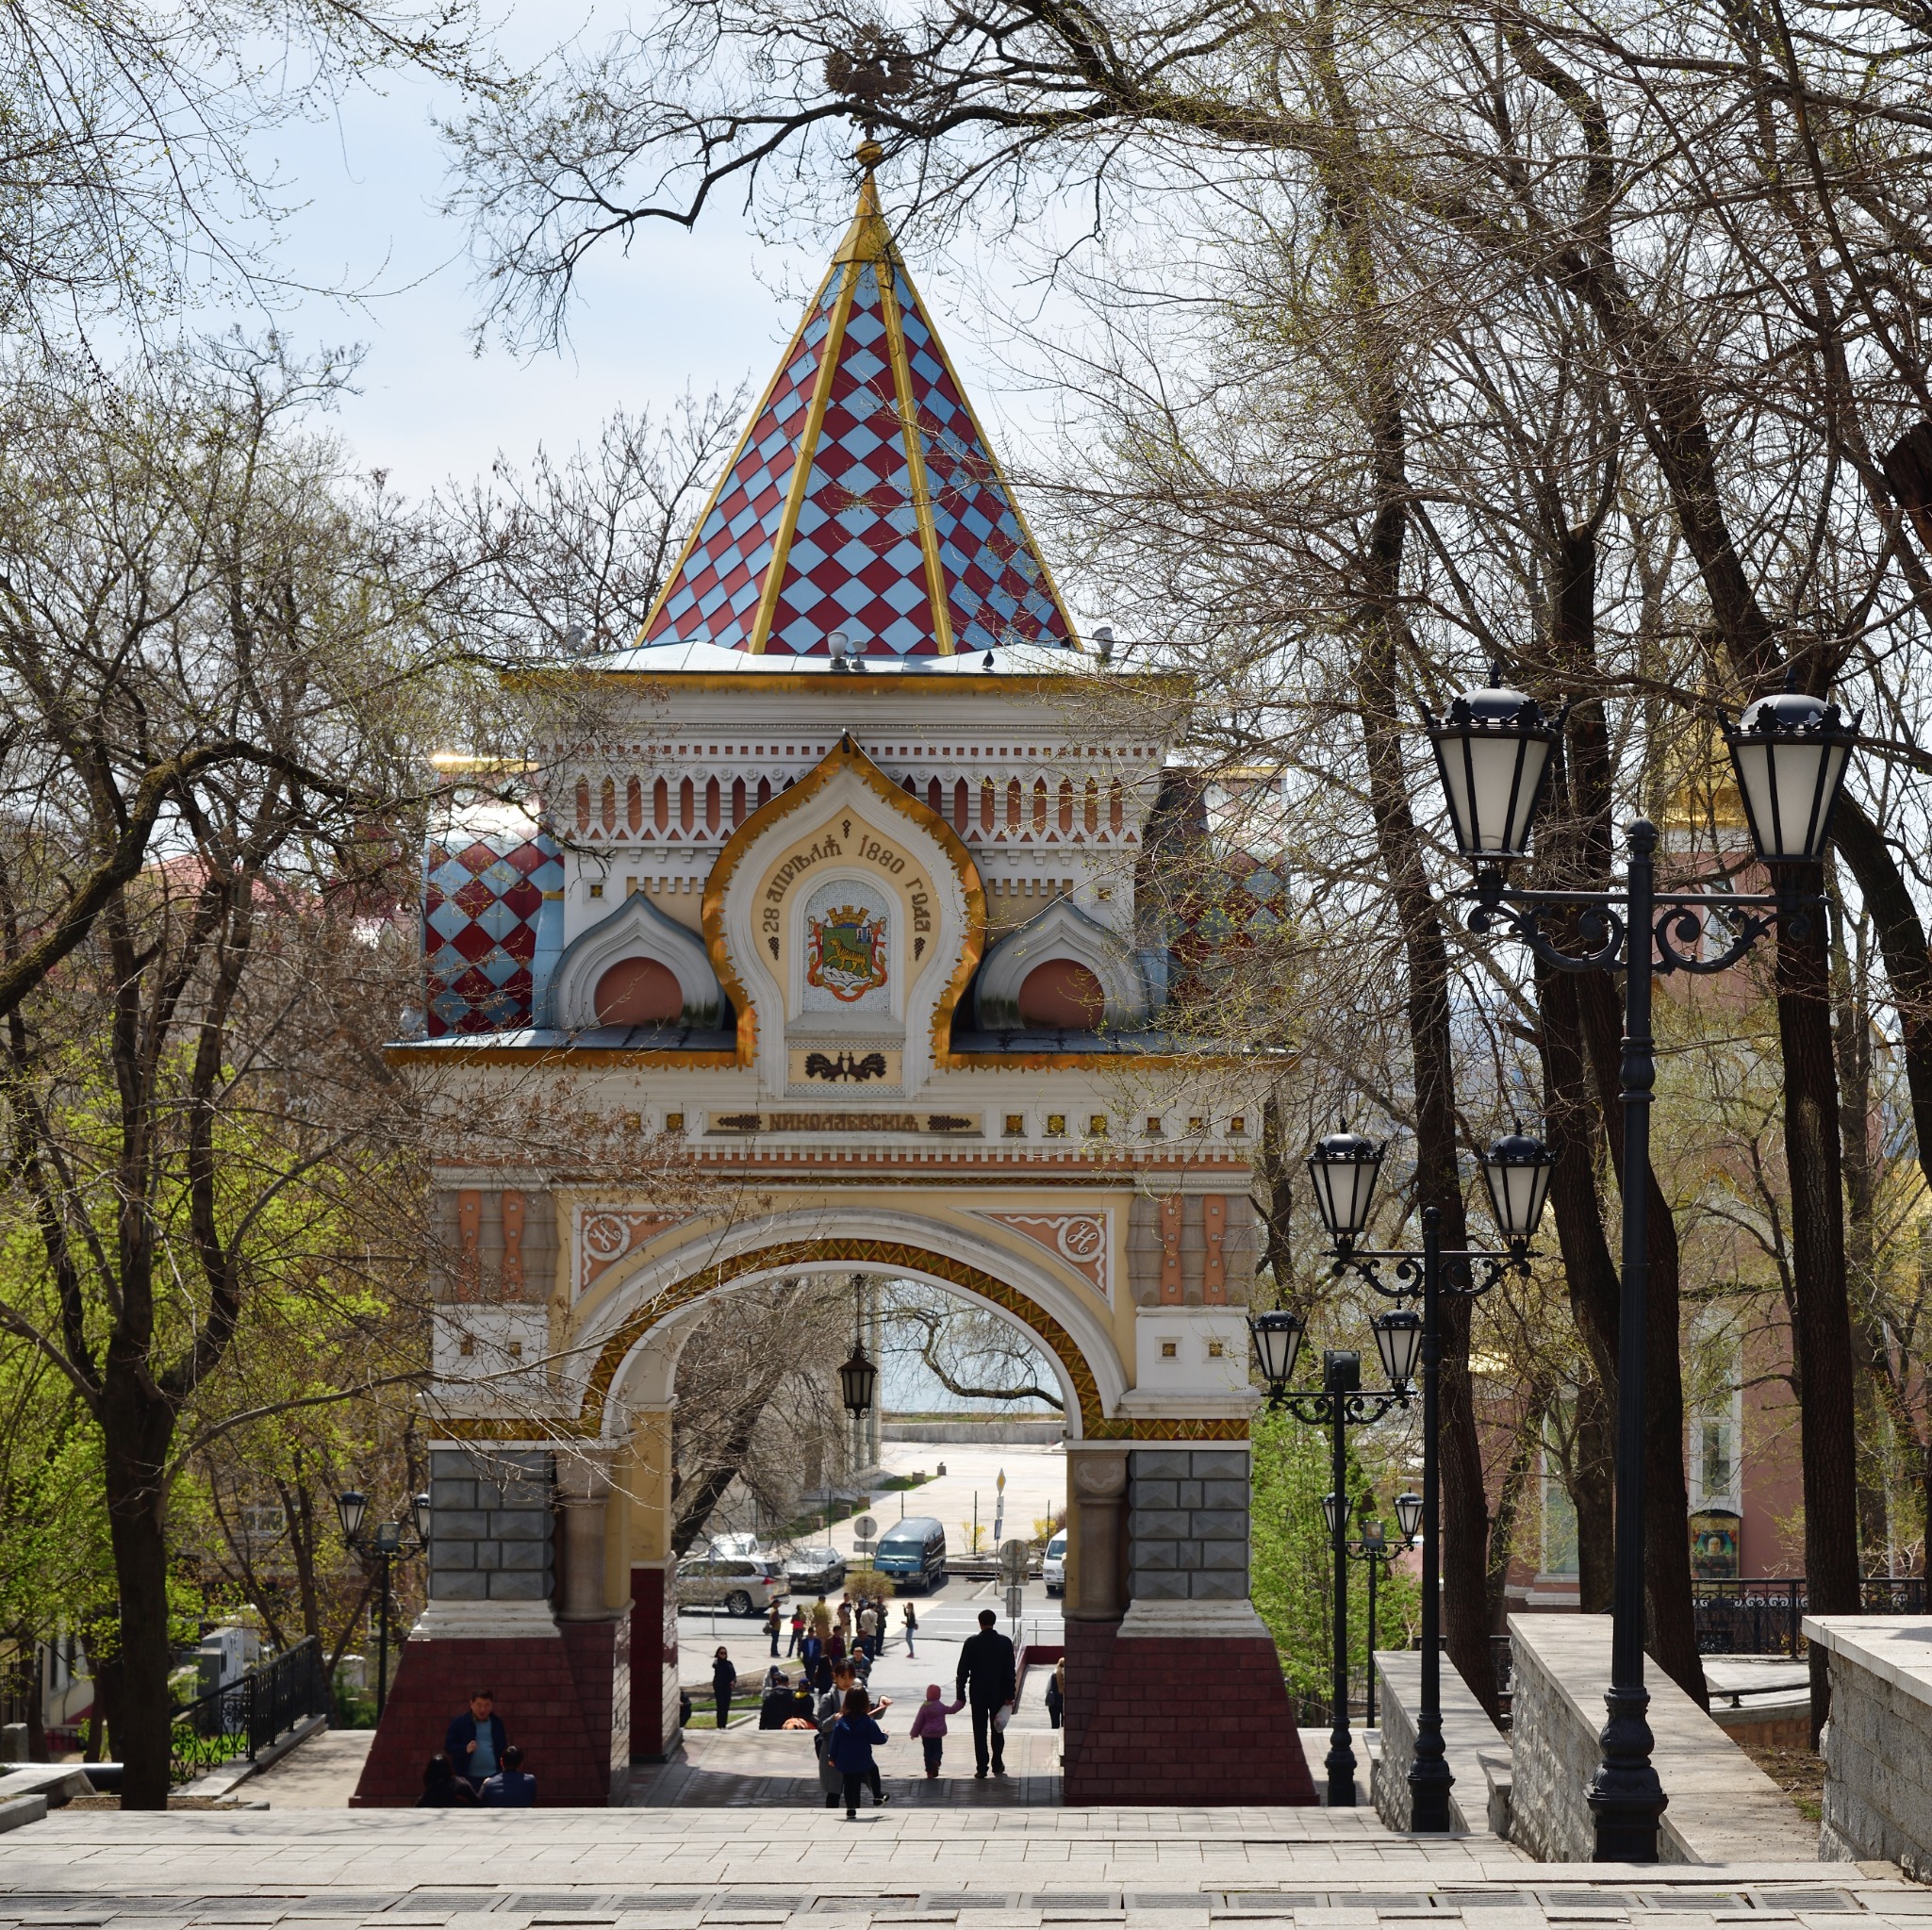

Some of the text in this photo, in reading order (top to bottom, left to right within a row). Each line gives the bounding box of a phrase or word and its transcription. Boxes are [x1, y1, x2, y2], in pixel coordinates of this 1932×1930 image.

[762, 907, 781, 932] 28
[857, 834, 905, 875] 1880
[904, 877, 932, 932] ГОДА
